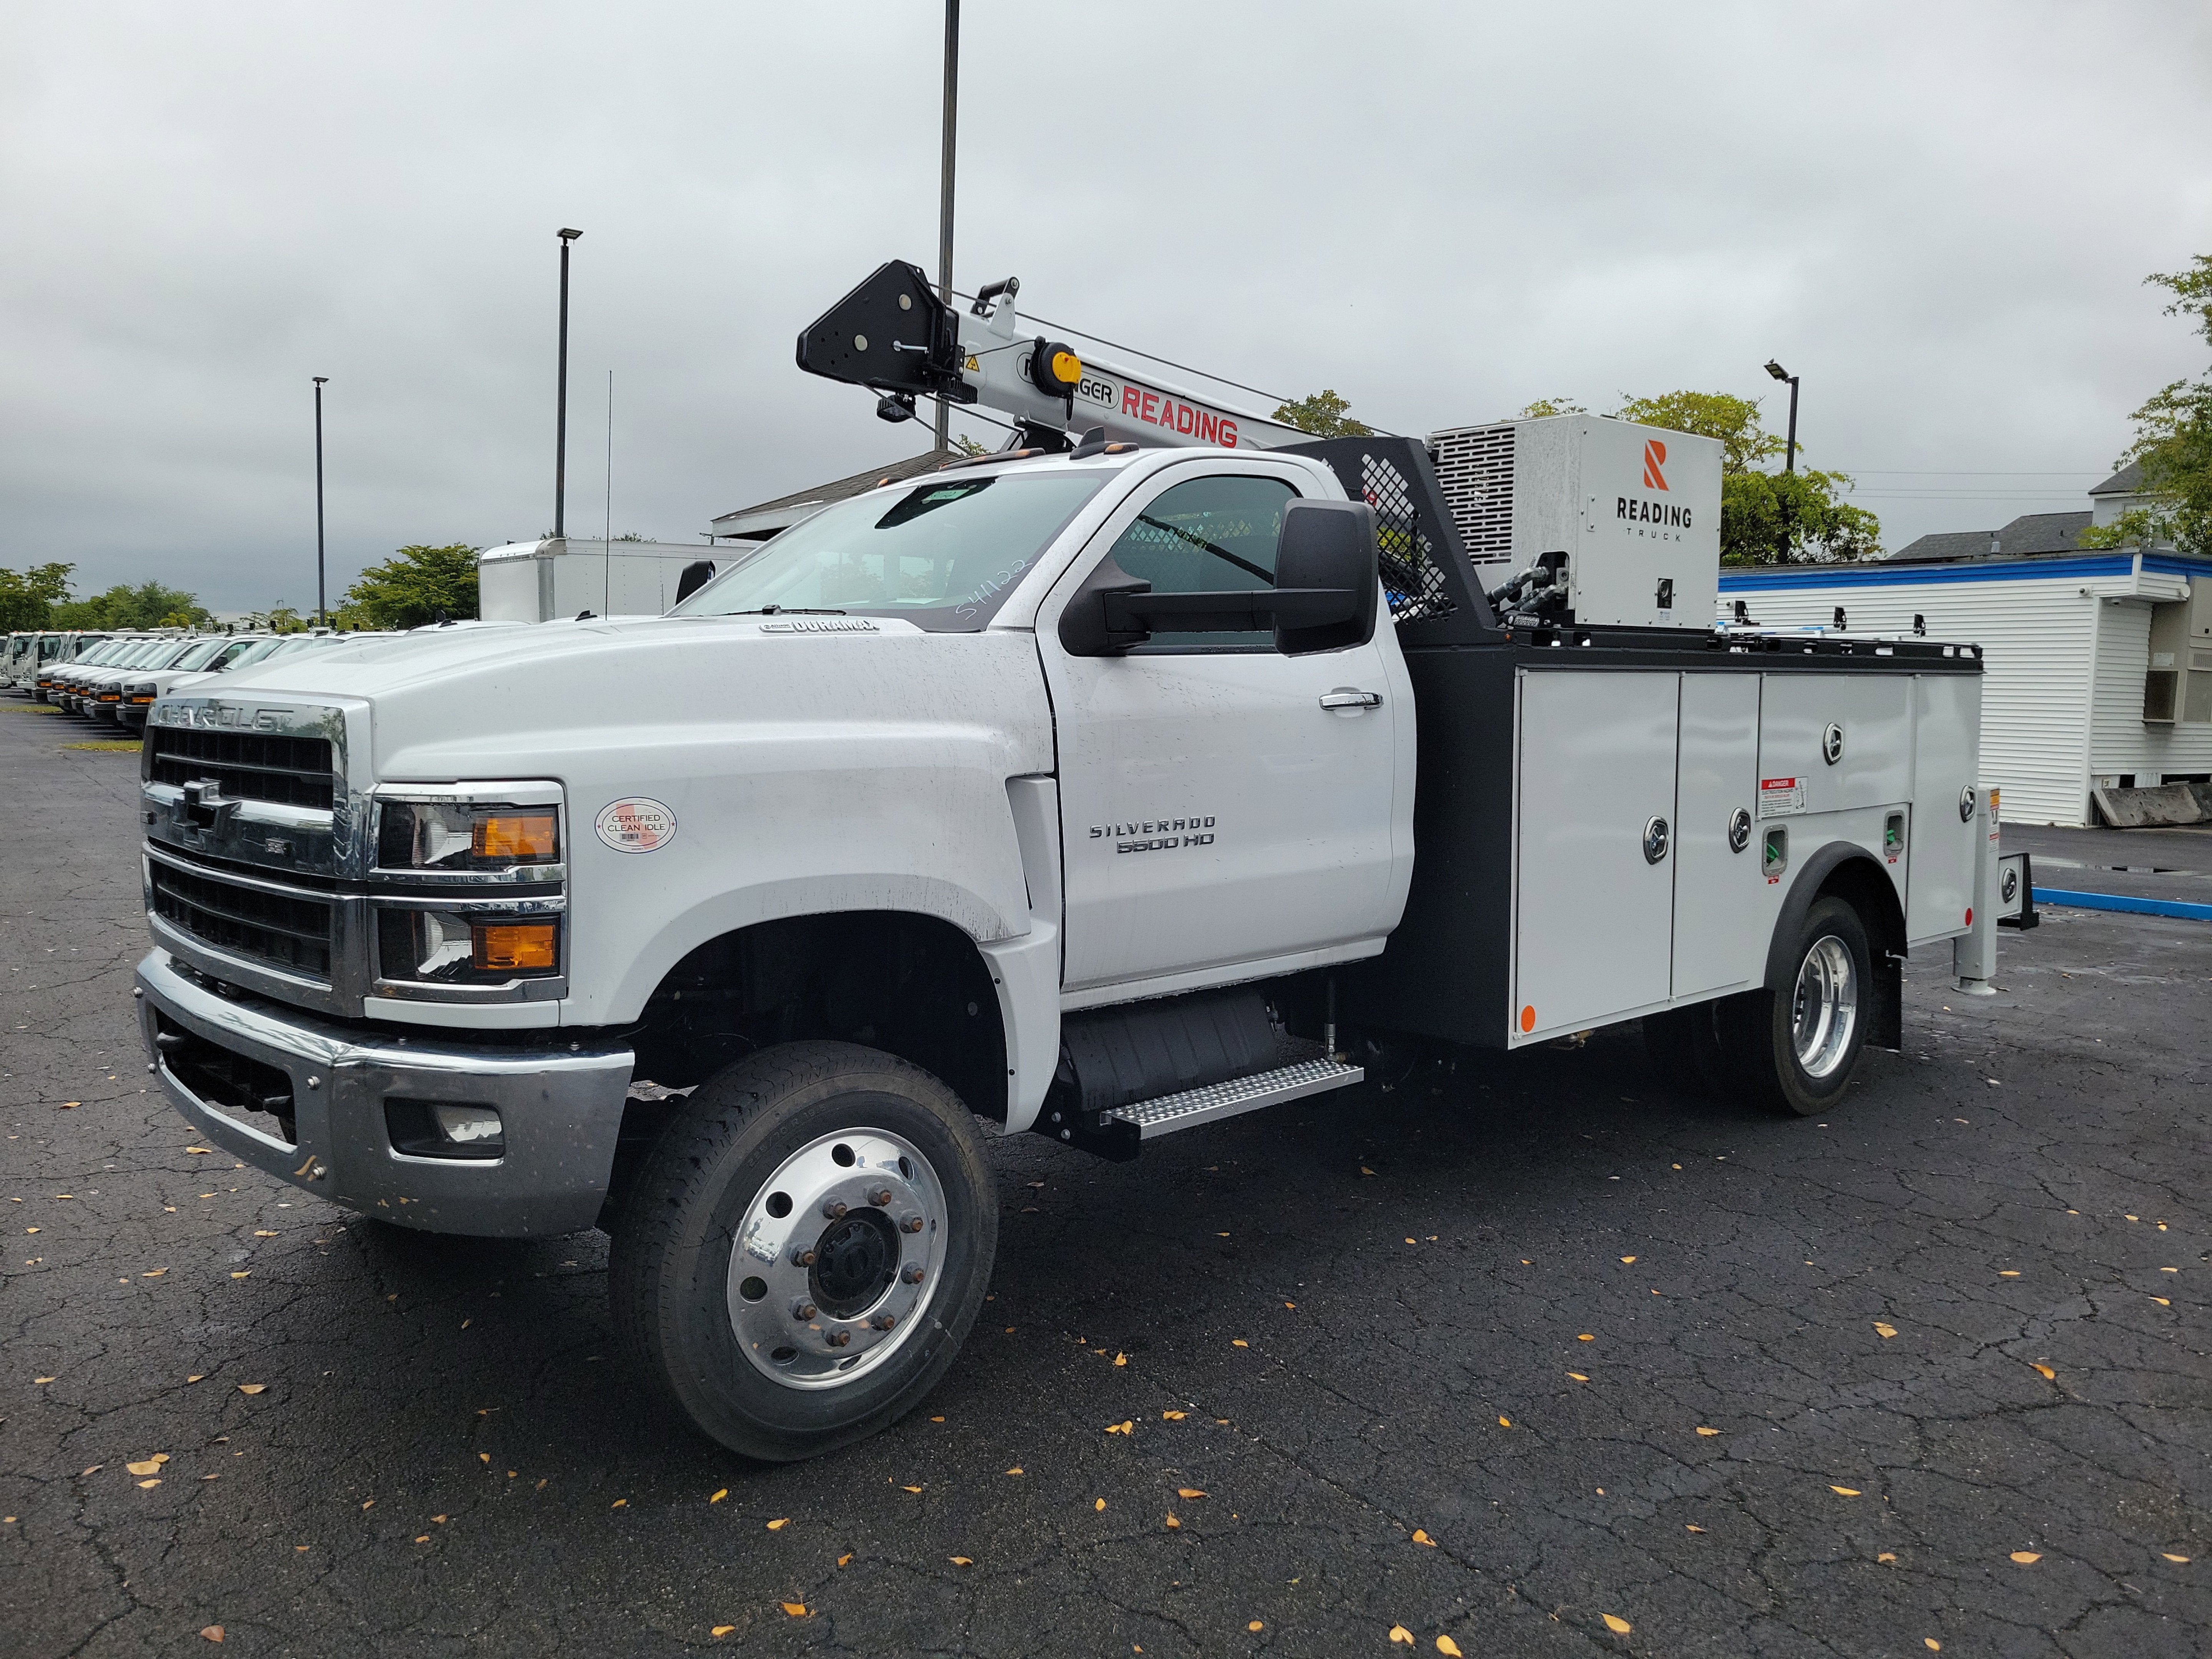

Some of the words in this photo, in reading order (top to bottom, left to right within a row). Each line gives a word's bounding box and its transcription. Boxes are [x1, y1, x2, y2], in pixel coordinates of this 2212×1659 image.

[1122, 386, 1238, 448] READING
[1617, 497, 1692, 528] READING
[1627, 528, 1681, 542] TRUCK
[792, 619, 880, 632] DURAMAX
[159, 704, 295, 732] CHEVROLET
[1089, 815, 1215, 838] SILVERADO
[1117, 836, 1179, 853] 5500
[1184, 833, 1214, 847] HD
